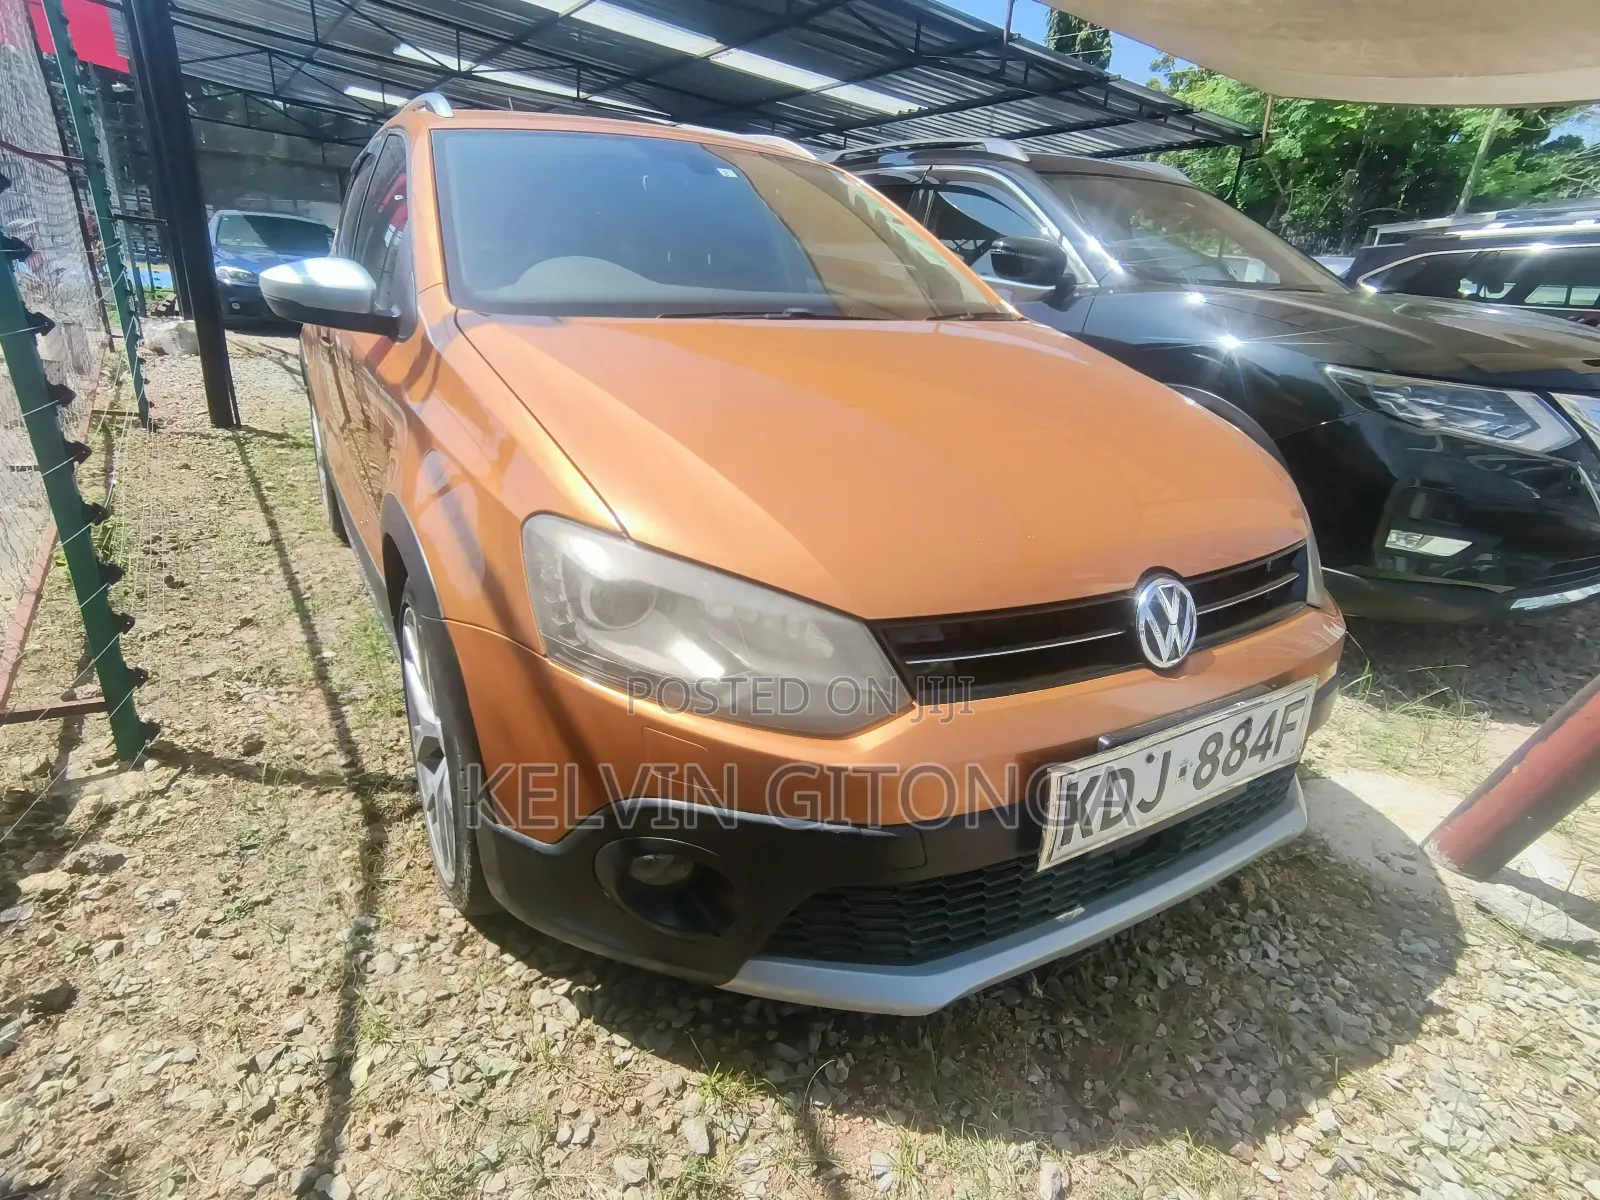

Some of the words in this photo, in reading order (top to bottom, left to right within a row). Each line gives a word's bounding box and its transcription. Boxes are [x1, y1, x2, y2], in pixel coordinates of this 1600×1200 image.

[1138, 579, 1197, 668] VW
[1059, 750, 1172, 846] KDJ
[1192, 702, 1305, 791] 884F
